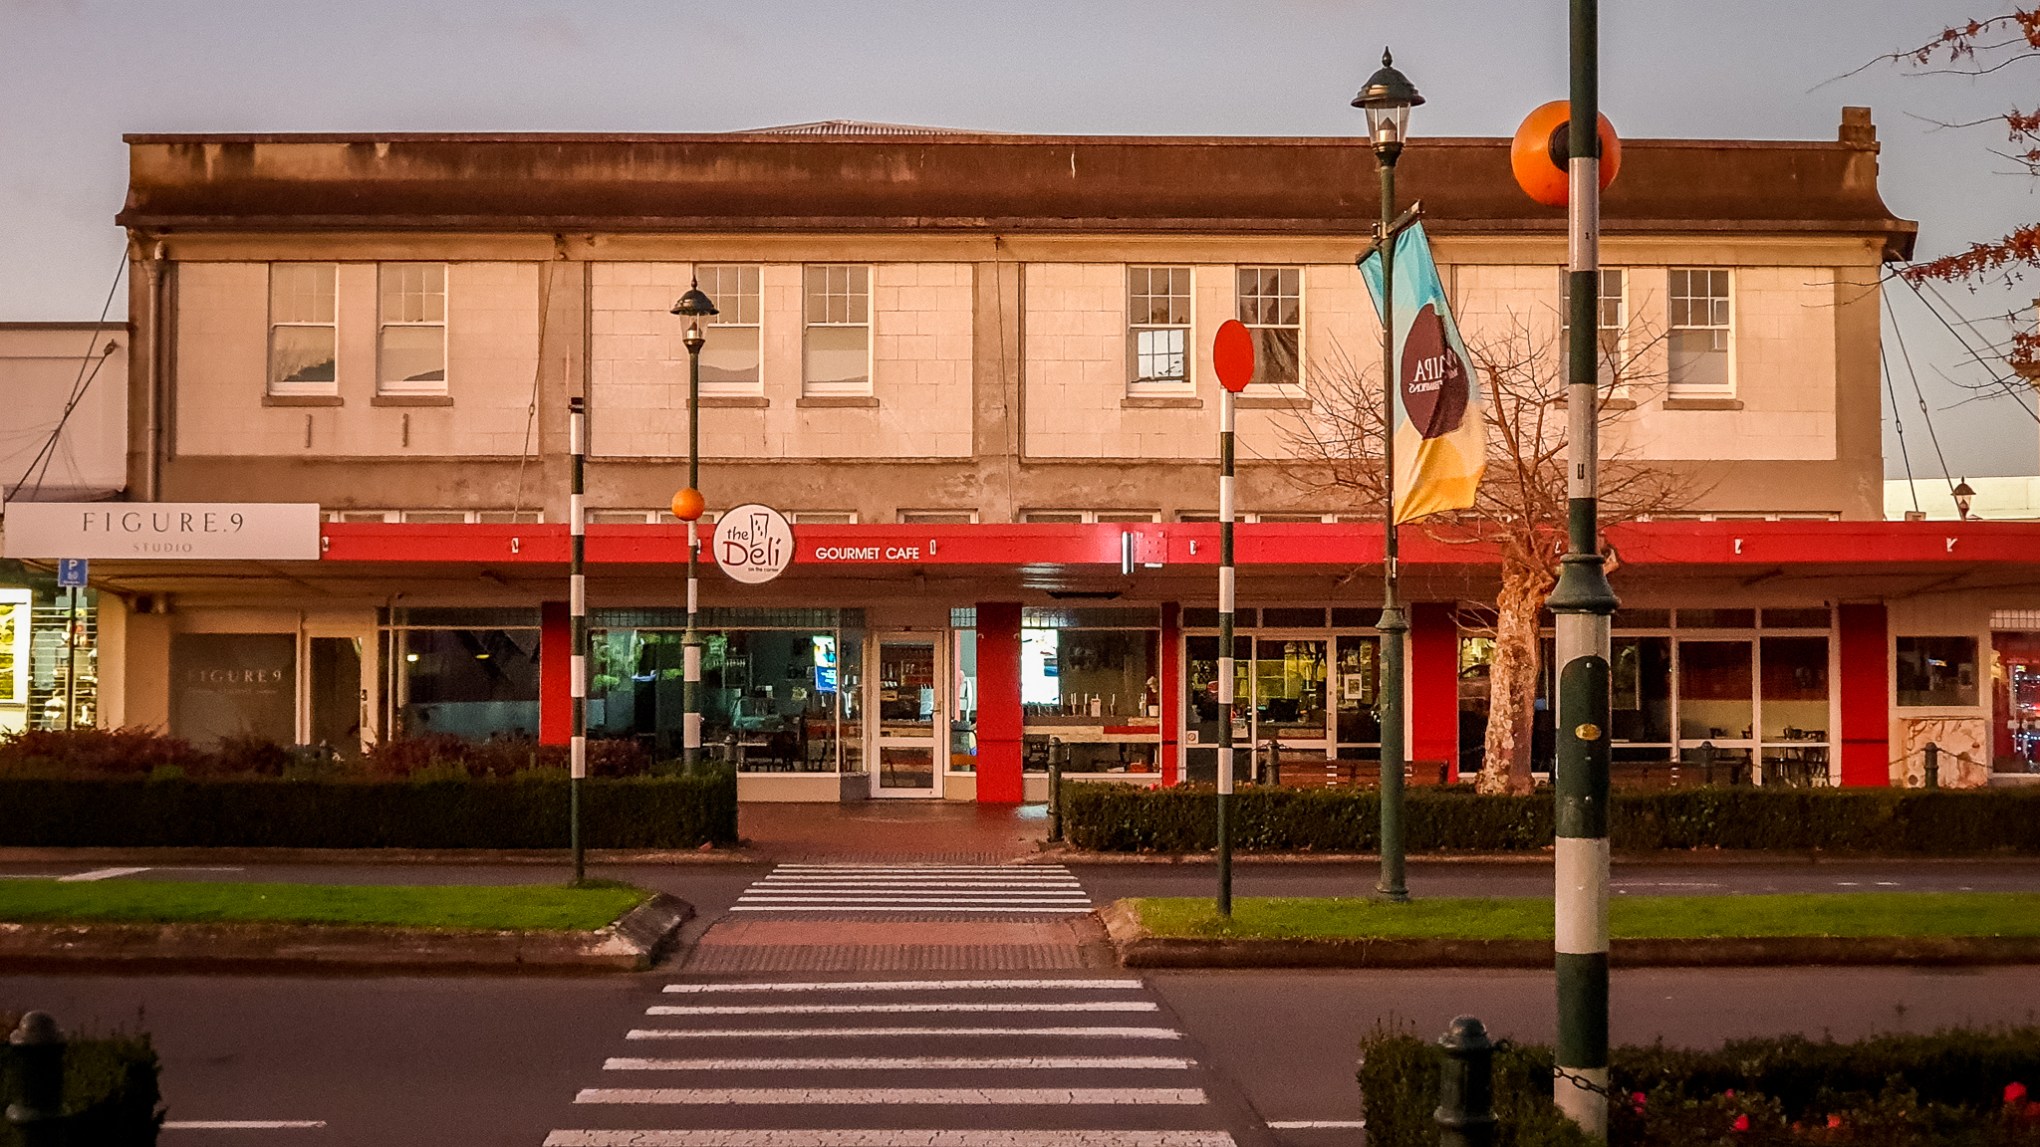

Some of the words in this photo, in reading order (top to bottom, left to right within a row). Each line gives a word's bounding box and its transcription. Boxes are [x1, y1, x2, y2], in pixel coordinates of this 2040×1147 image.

[83, 512, 244, 533] FIGURE.9
[727, 526, 749, 541] the
[132, 543, 194, 553] STUDIO
[722, 536, 781, 566] Deli
[815, 547, 880, 560] GOURMET
[885, 547, 920, 560] CAFE
[68, 559, 78, 571] P
